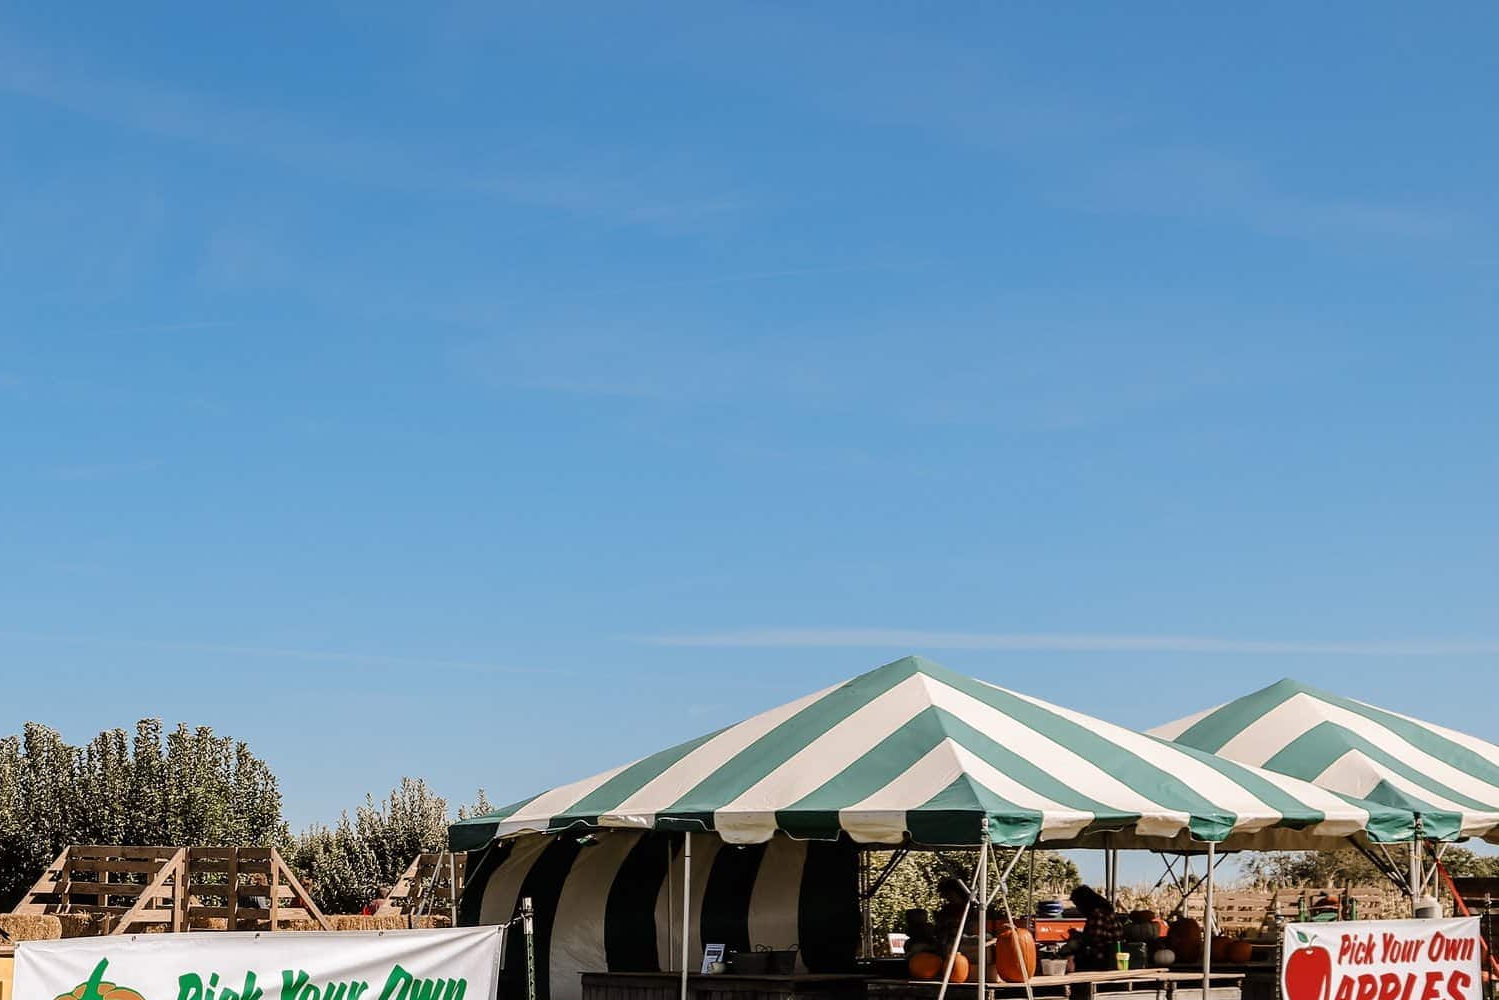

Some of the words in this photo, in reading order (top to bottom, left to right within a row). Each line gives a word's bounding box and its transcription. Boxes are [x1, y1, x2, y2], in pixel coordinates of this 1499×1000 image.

[1337, 932, 1376, 965] Pick
[1381, 931, 1425, 964] Your
[1428, 930, 1475, 963] Own
